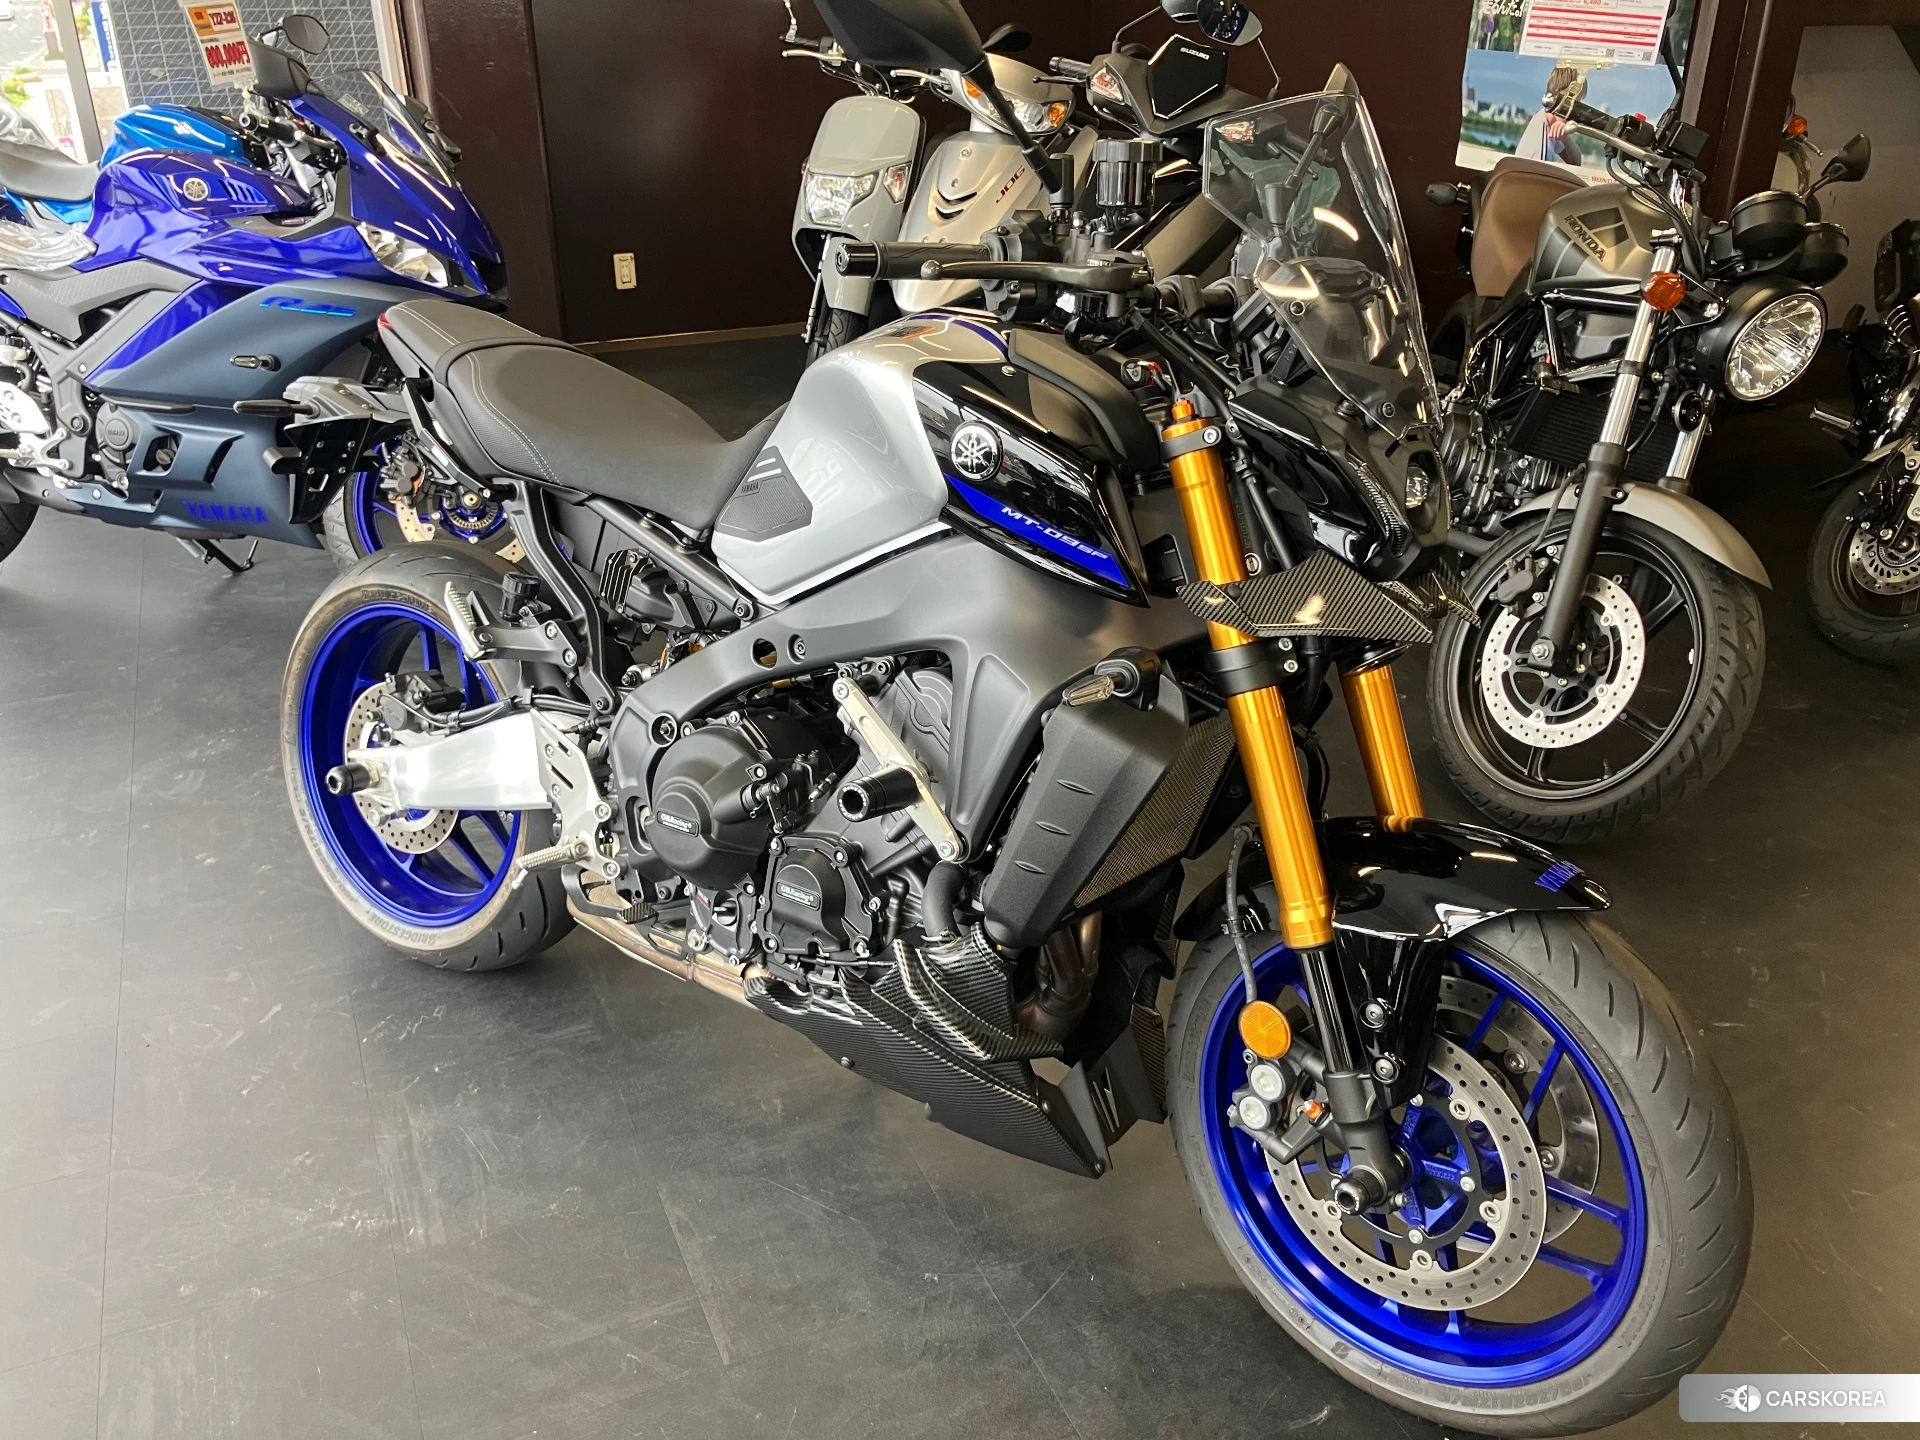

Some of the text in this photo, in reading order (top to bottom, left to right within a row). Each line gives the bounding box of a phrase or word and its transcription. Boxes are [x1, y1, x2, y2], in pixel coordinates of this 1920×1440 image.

[1180, 47, 1210, 60] SUZUKI
[995, 165, 1025, 203] JOG
[1564, 214, 1606, 262] HONDA
[183, 501, 269, 525] YAMAHA
